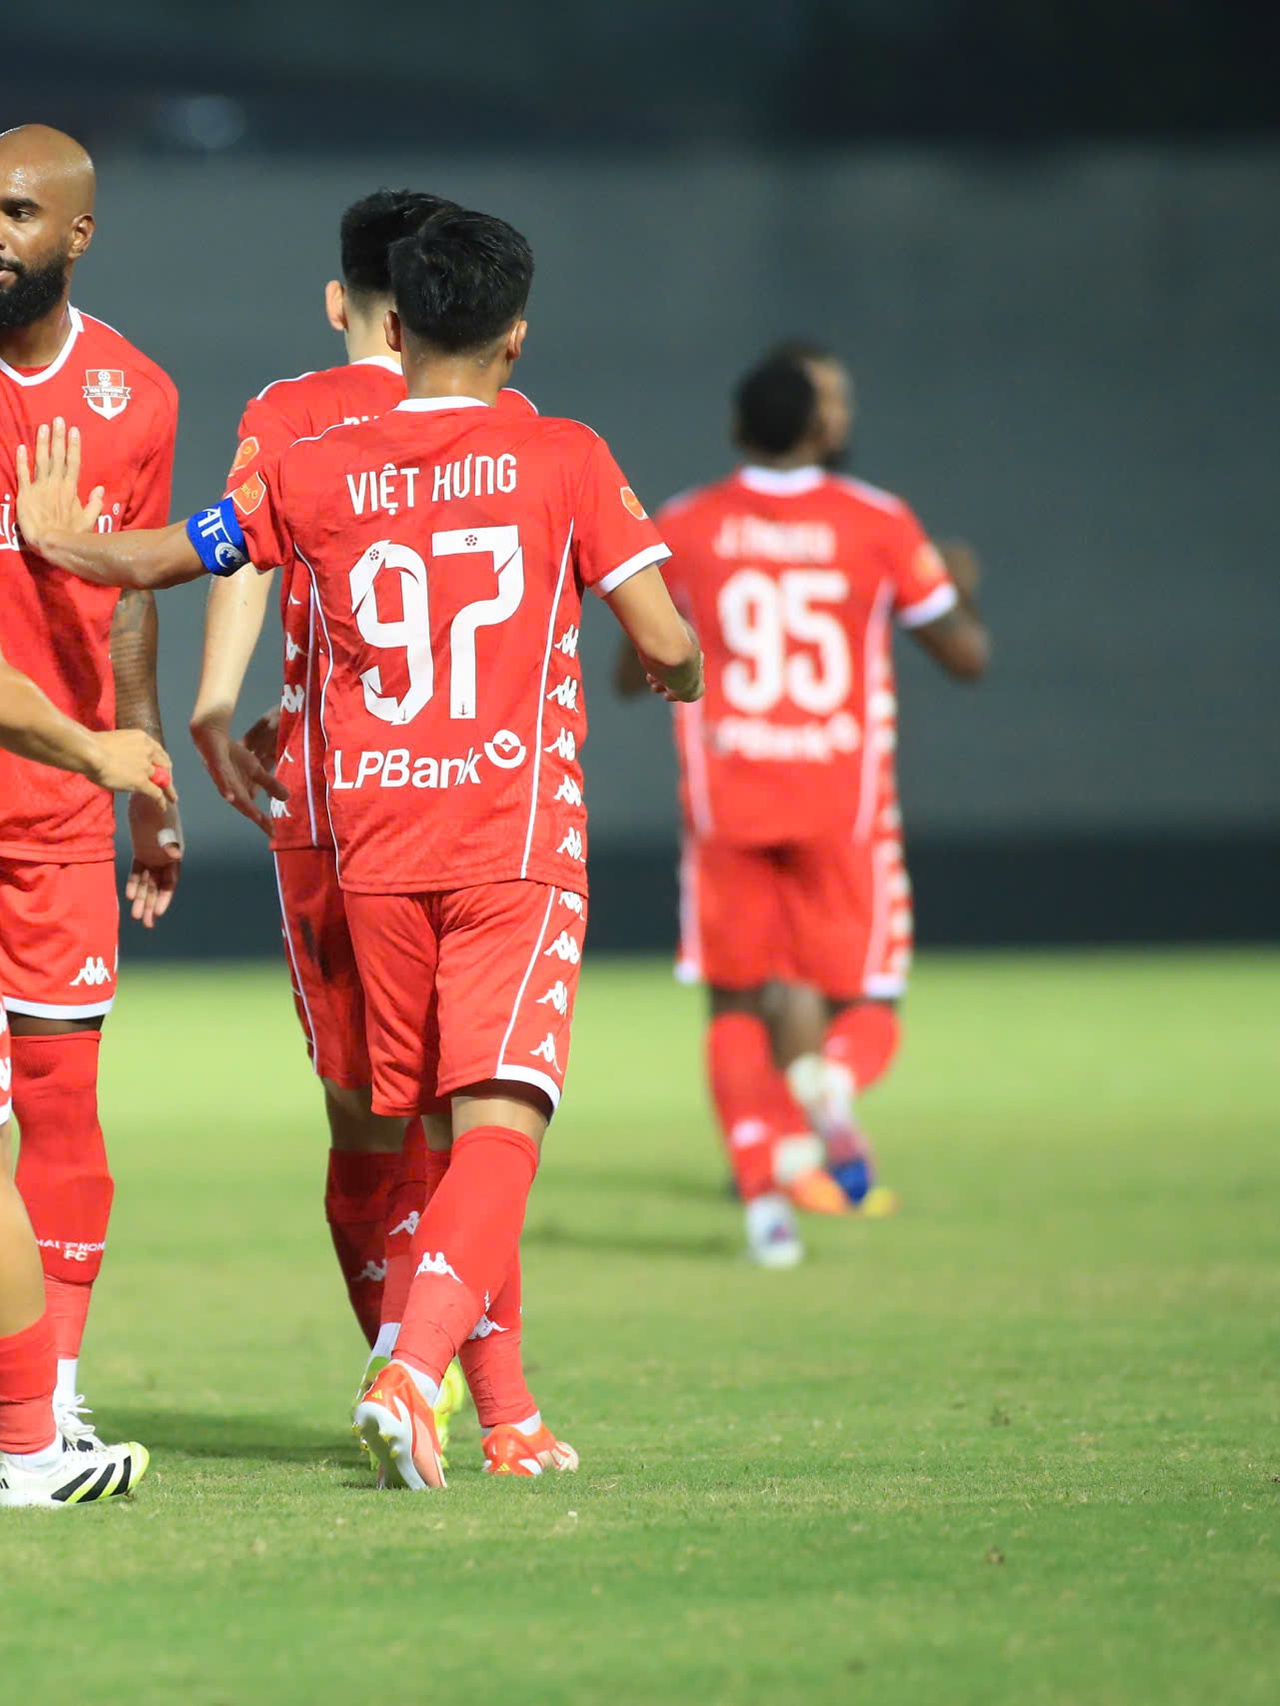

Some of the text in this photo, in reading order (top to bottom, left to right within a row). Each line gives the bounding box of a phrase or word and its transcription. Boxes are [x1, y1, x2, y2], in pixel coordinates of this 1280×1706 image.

[345, 452, 517, 516] VIỆT HƯNG
[348, 524, 525, 726] 97
[718, 569, 851, 715] 95
[332, 747, 483, 790] LPBank
[63, 1241, 106, 1252] PHON
[64, 1250, 88, 1262] FC
